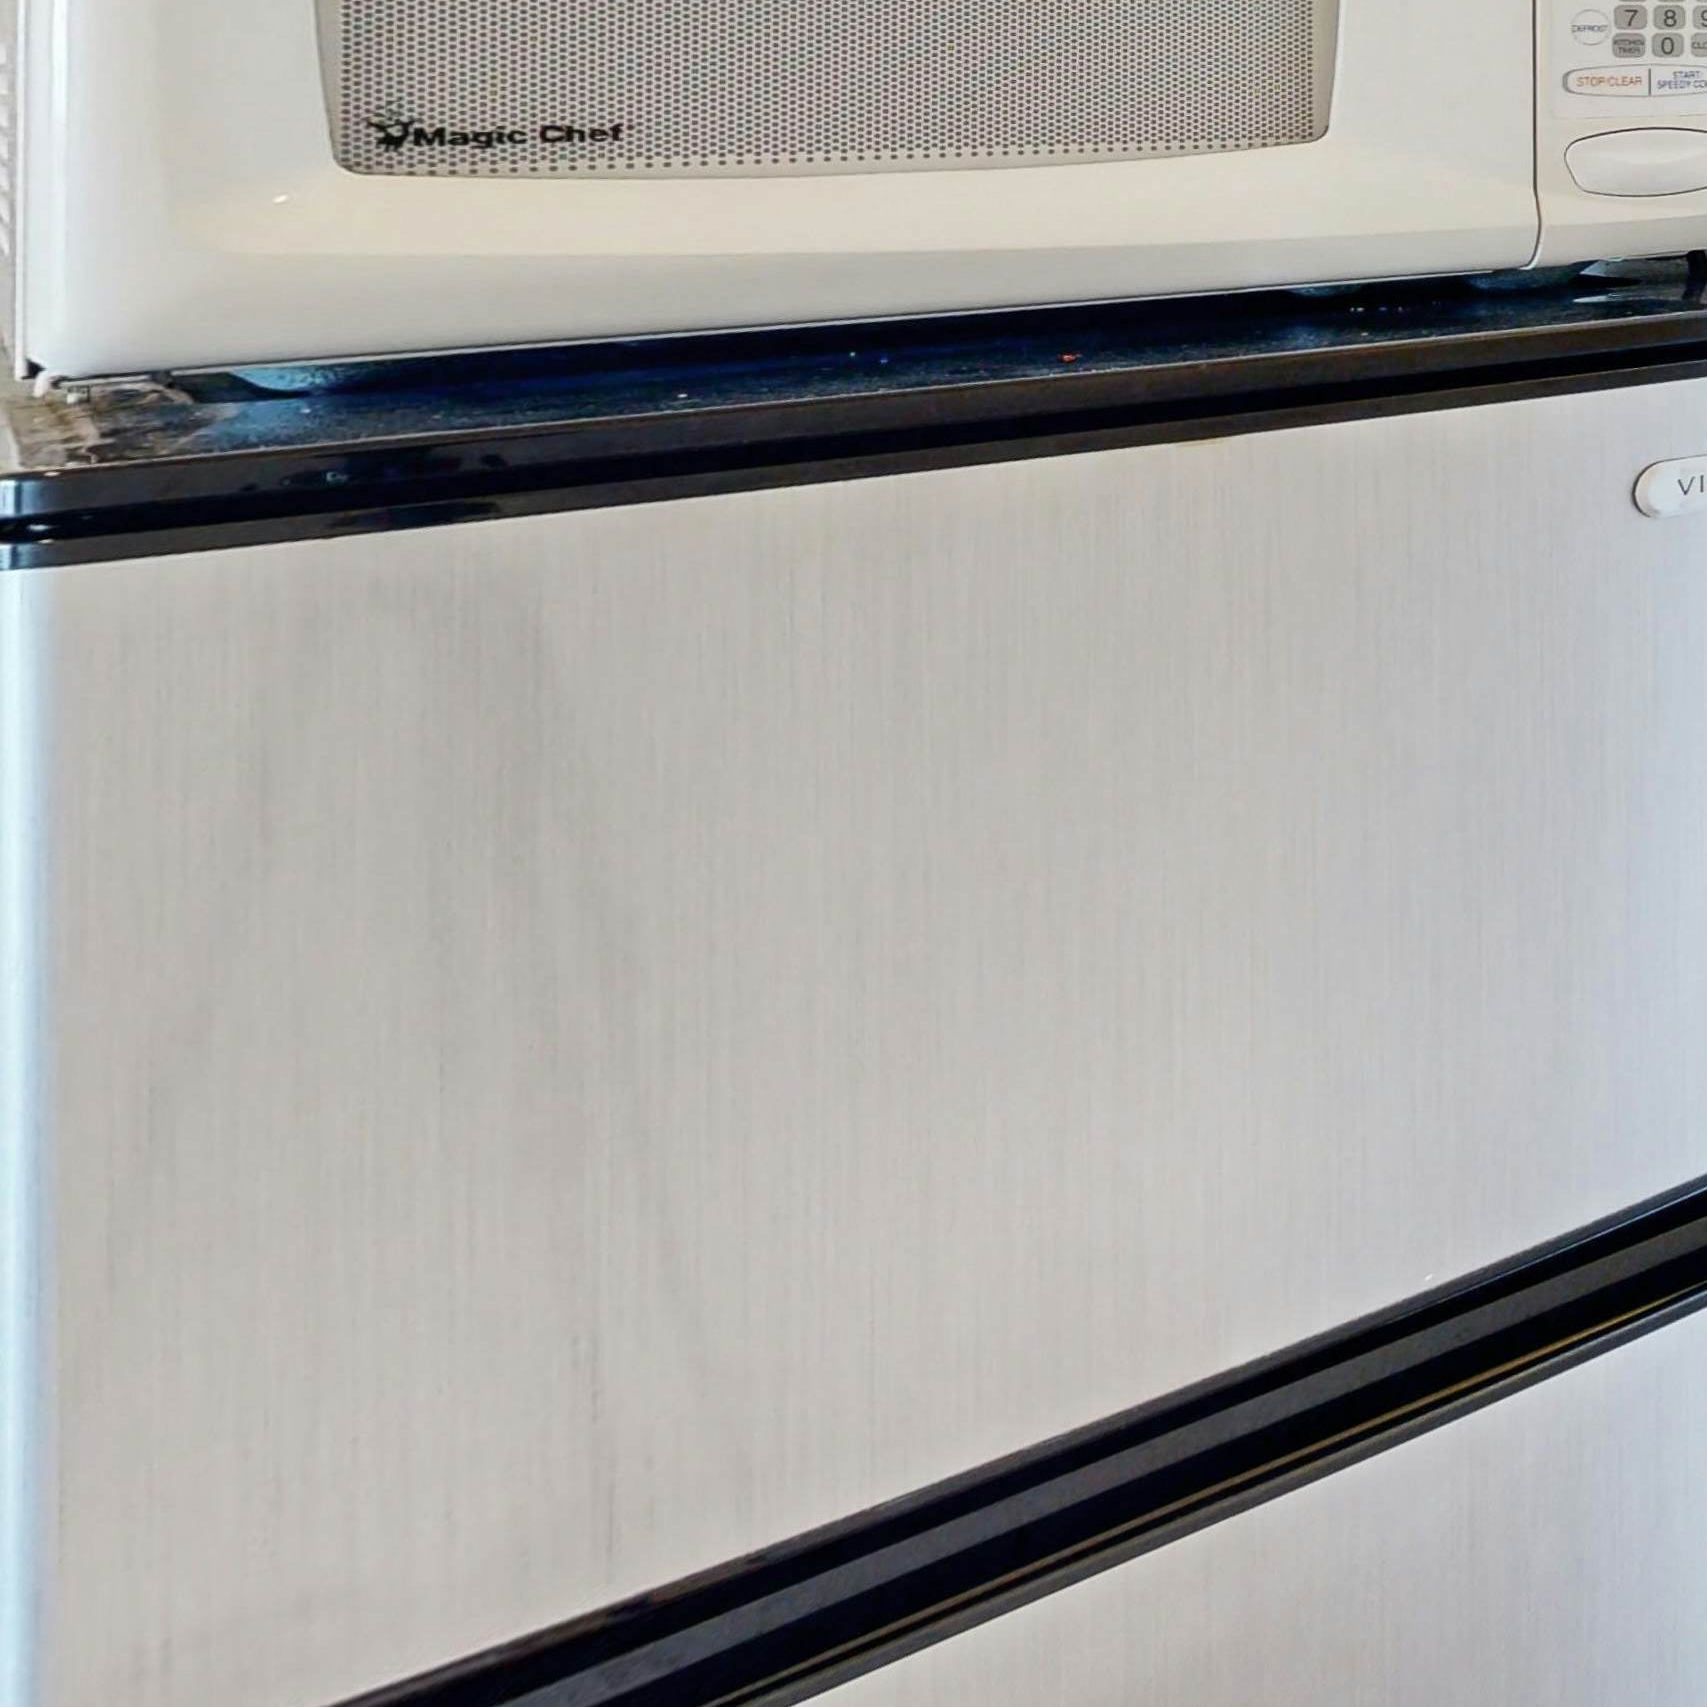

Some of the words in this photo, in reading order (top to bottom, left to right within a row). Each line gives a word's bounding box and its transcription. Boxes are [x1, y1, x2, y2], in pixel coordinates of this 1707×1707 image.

[1624, 9, 1639, 27] 7
[1663, 9, 1678, 28] 8
[1571, 24, 1609, 33] DEFROST
[1660, 36, 1675, 55] 0
[1672, 70, 1702, 79] START
[1657, 80, 1691, 90] SPEEDY
[413, 125, 528, 148] Magic
[539, 123, 625, 144] Chef
